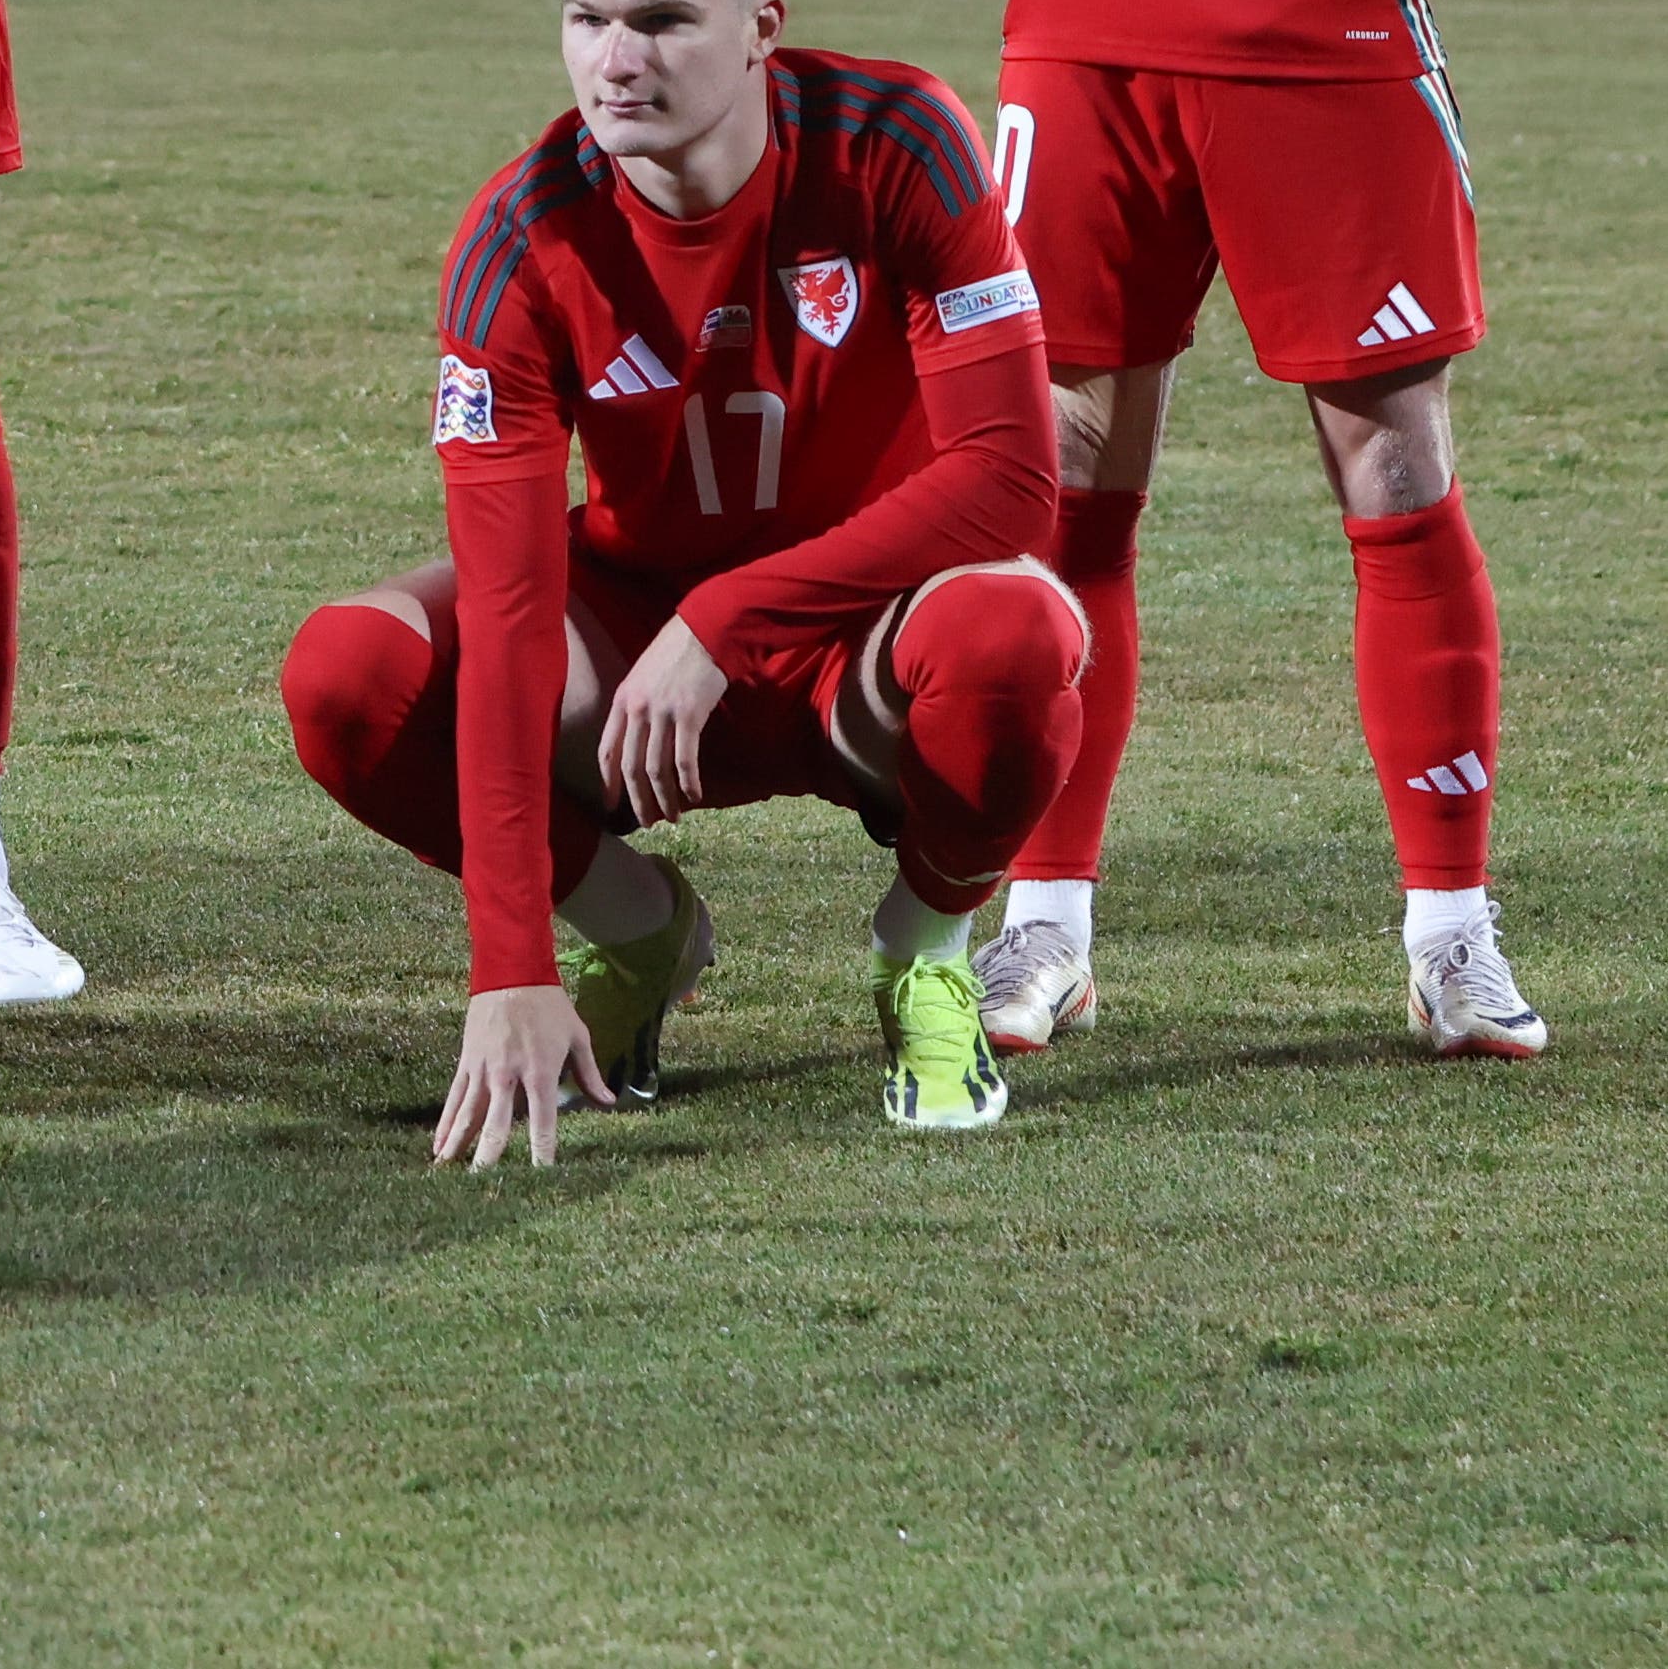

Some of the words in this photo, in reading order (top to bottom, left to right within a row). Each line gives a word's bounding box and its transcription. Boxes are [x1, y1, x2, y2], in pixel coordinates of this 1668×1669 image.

[1345, 30, 1390, 40] AEROREADY
[939, 292, 966, 305] UEFA
[683, 391, 786, 515] 17
